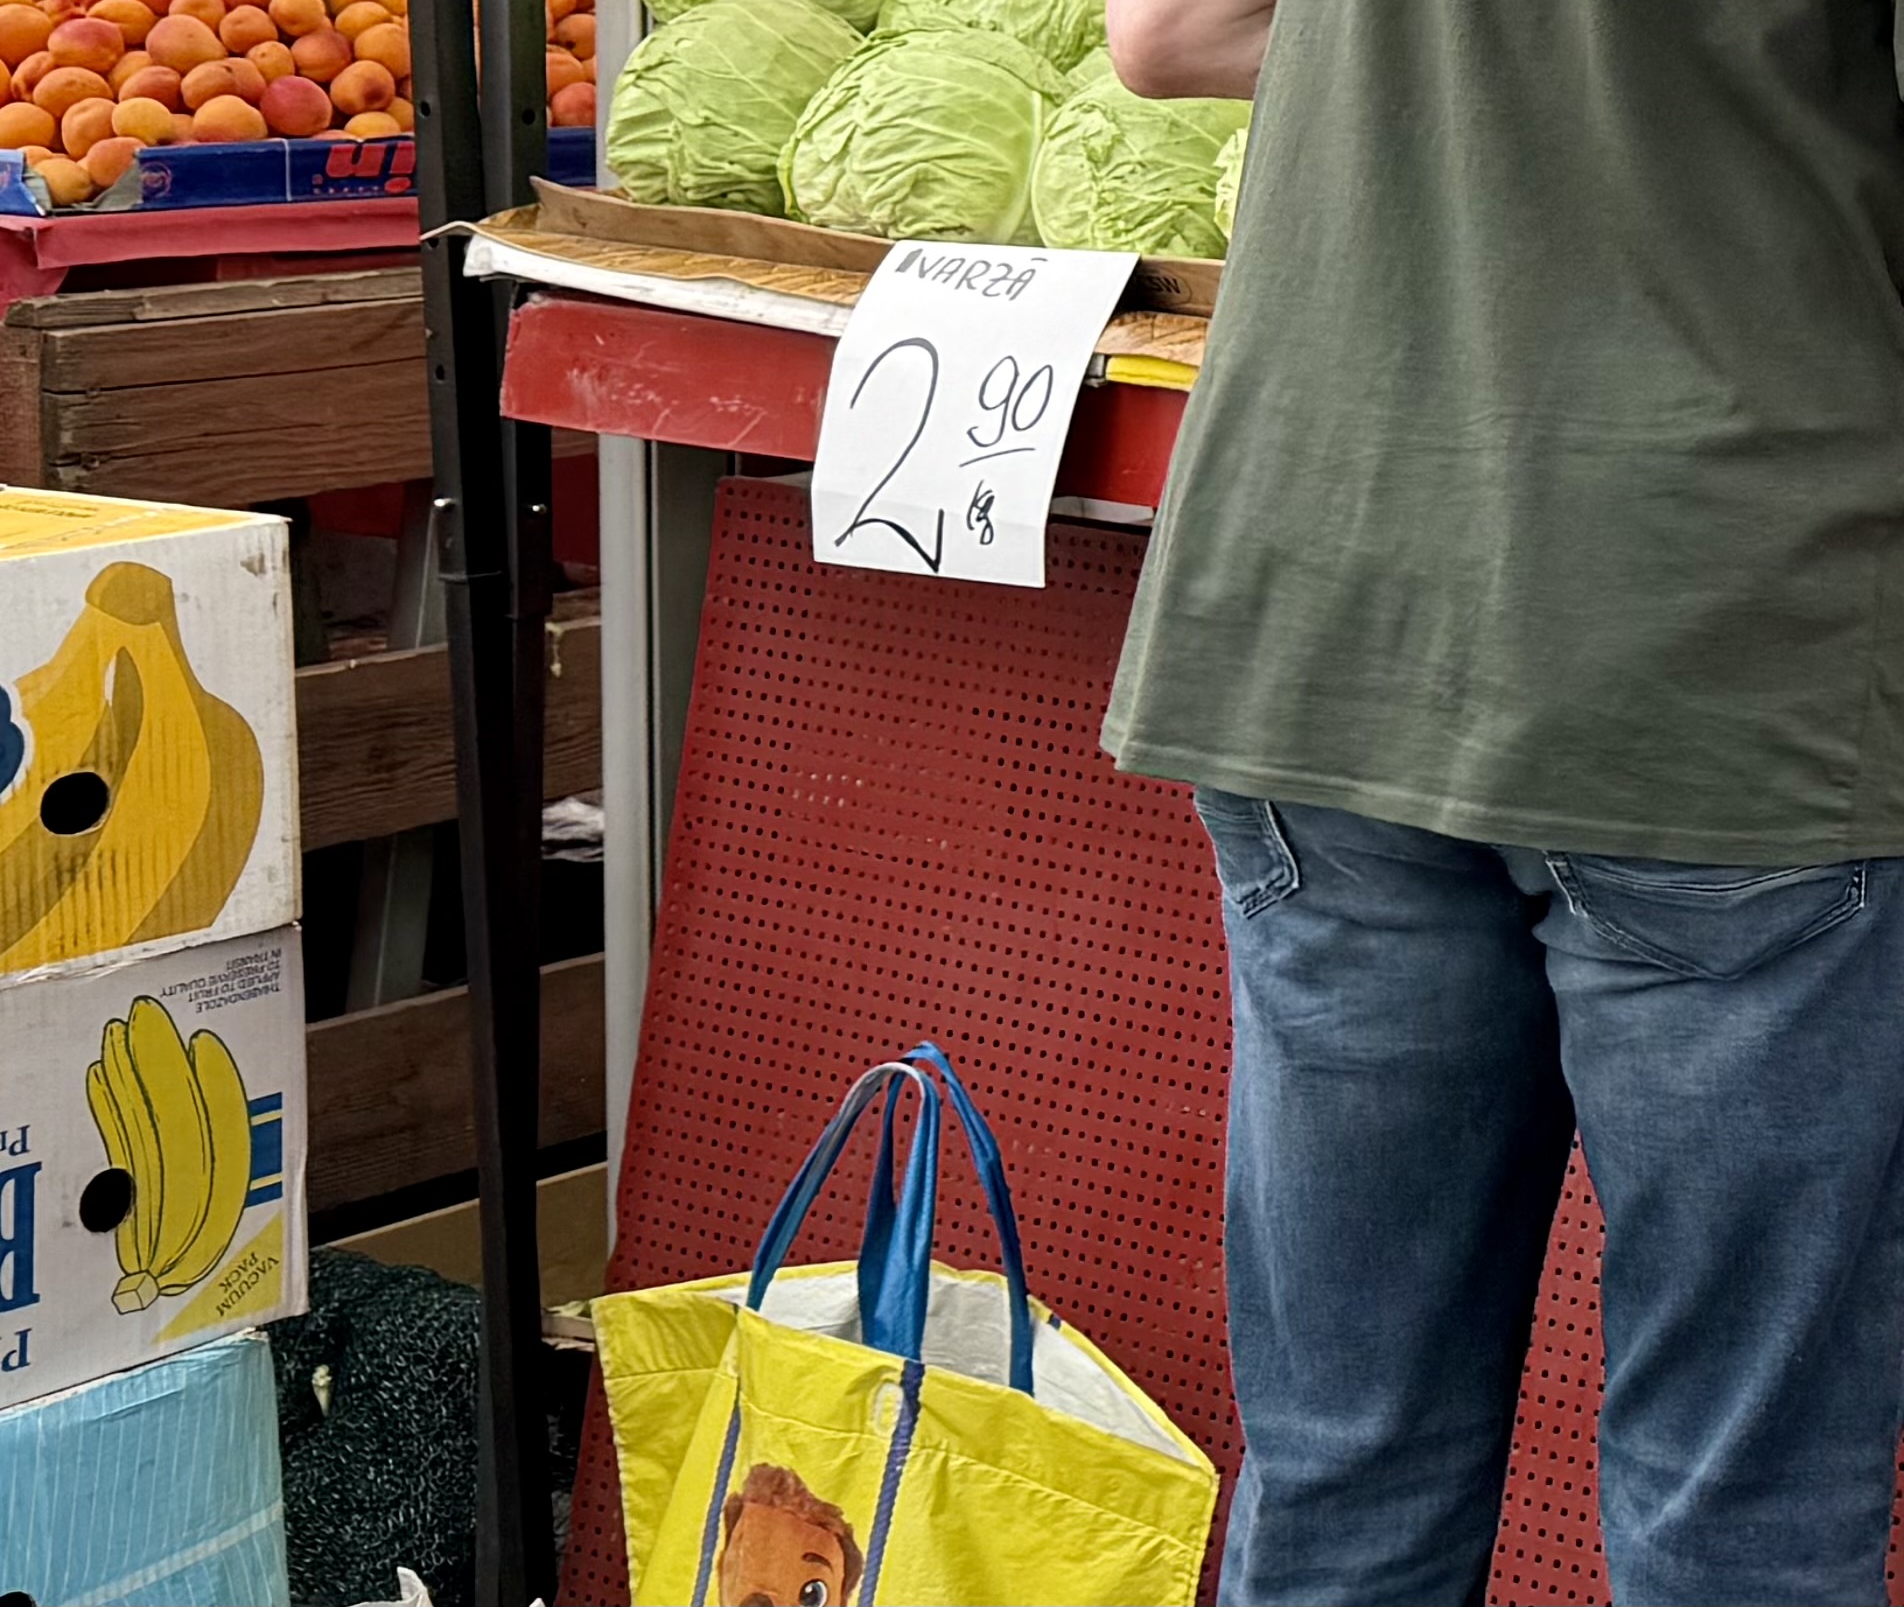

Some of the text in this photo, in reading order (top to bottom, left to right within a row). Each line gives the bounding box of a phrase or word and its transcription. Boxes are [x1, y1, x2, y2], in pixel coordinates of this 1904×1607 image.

[159, 977, 206, 998] QUALITY
[188, 986, 219, 1003] FRUIT
[215, 1256, 280, 1317] VACUUM
[218, 1251, 259, 1293] PACK
